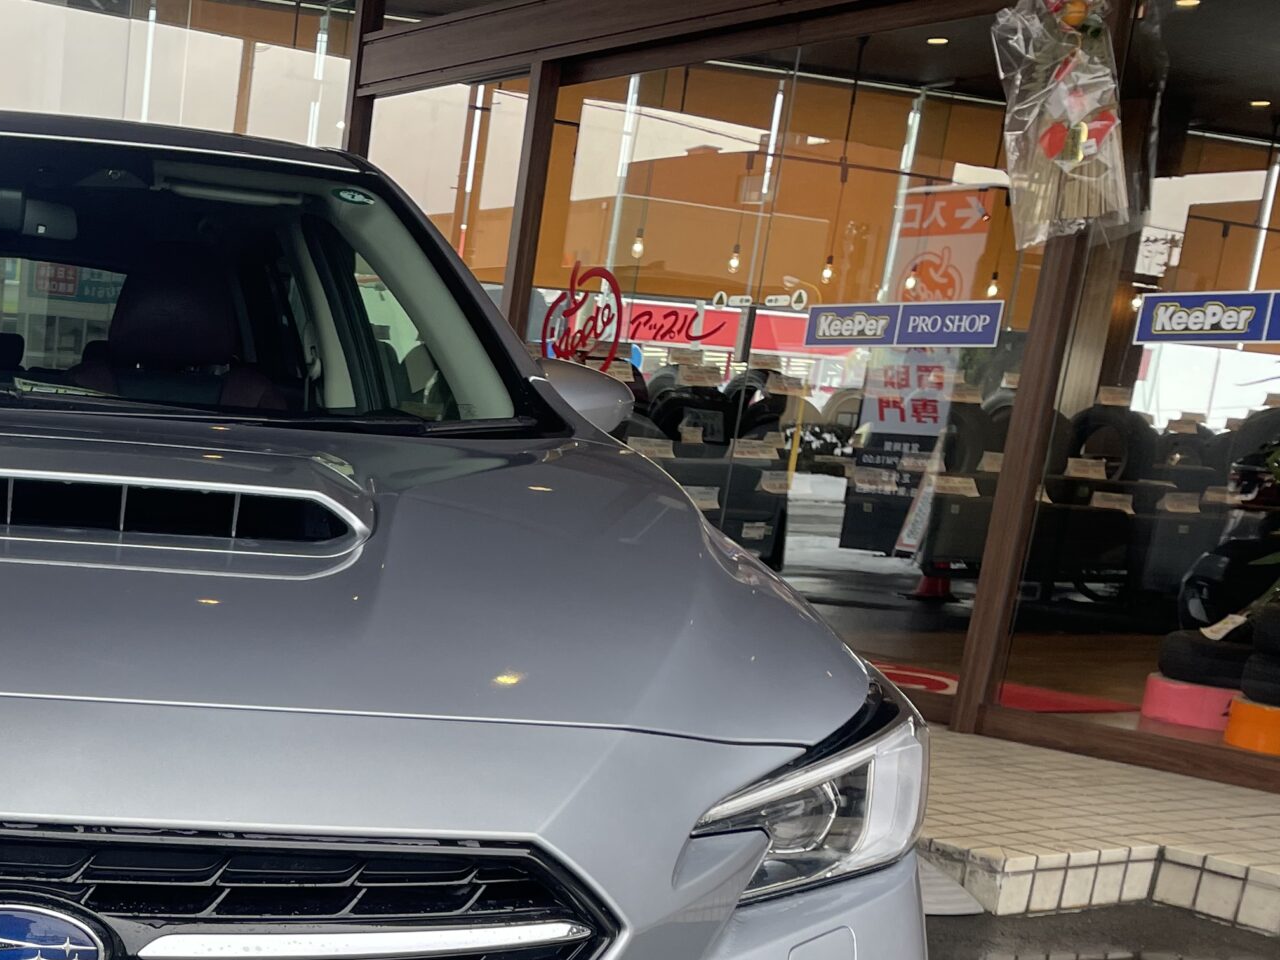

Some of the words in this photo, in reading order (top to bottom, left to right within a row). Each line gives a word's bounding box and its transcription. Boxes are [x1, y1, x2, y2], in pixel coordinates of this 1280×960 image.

[818, 313, 888, 337] KeePer
[907, 315, 942, 333] PRO
[943, 314, 990, 333] SHOP
[1154, 303, 1254, 332] KeePer
